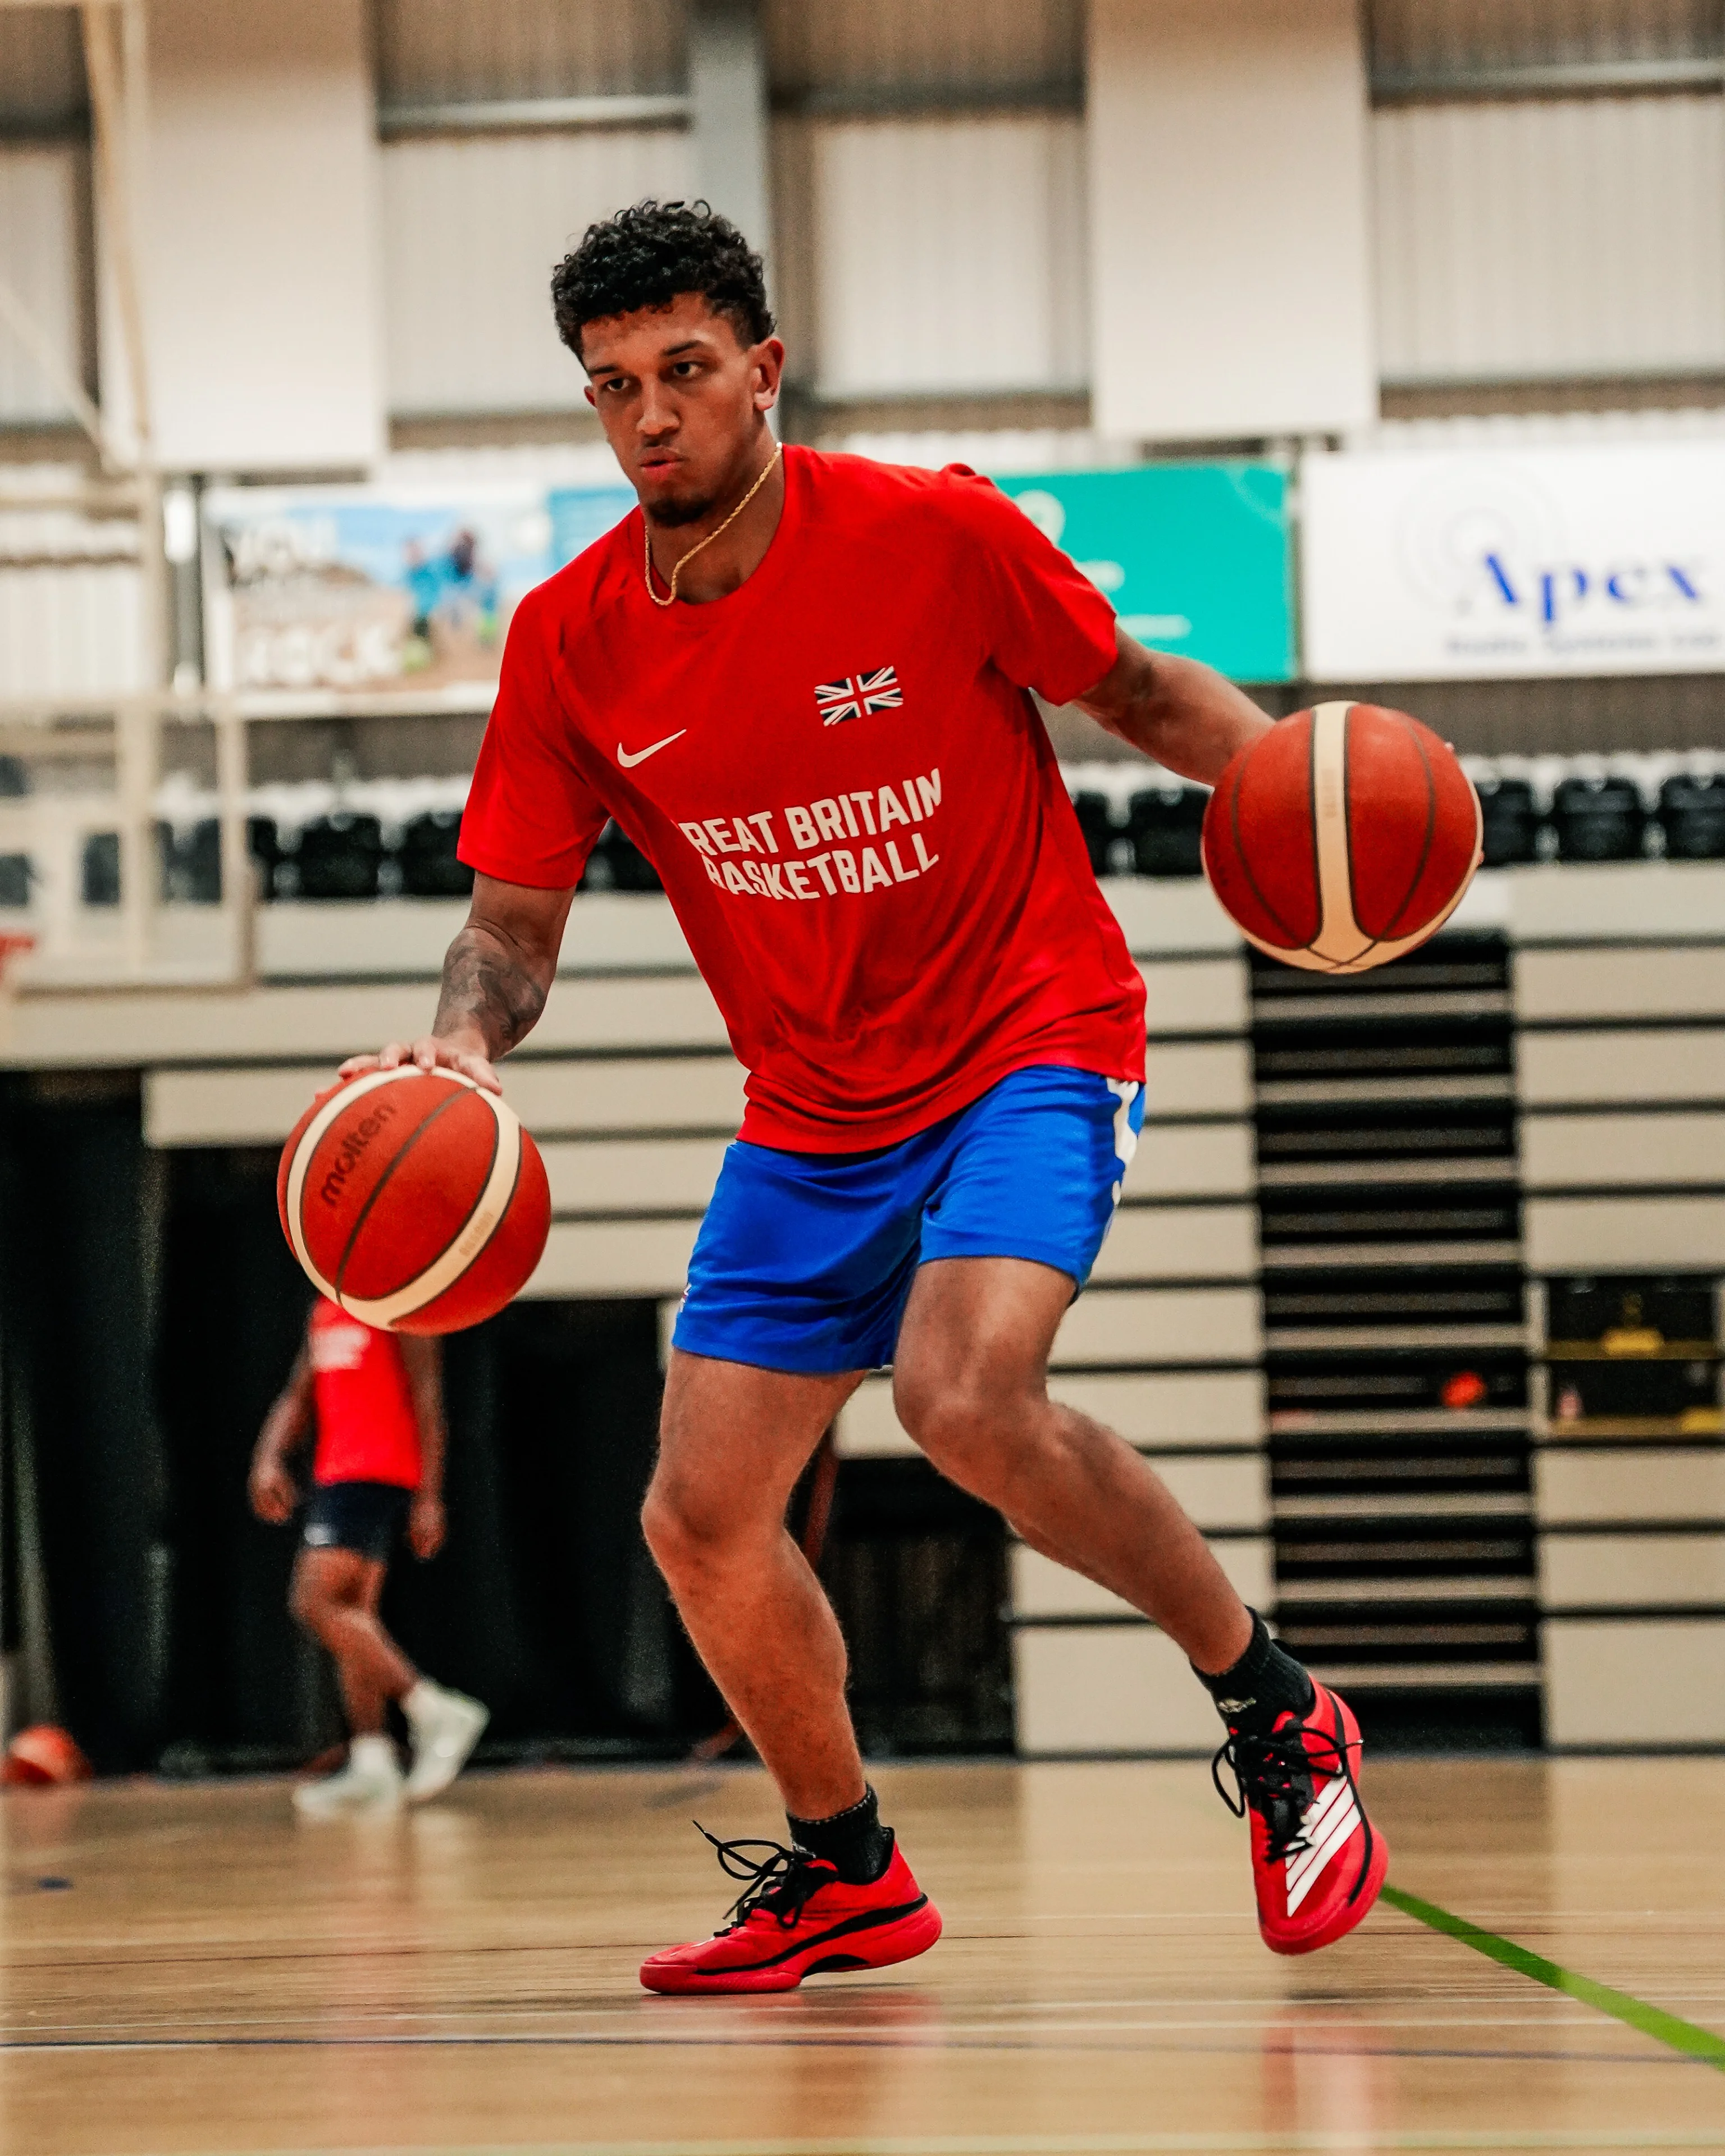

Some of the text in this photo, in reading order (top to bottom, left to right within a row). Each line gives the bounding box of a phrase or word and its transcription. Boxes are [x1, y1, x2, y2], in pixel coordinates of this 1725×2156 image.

[1459, 552, 1703, 625] Apex
[678, 768, 942, 856] REAT BRITAIN
[702, 833, 939, 899] BASKETBALL
[322, 1104, 395, 1205] molten
